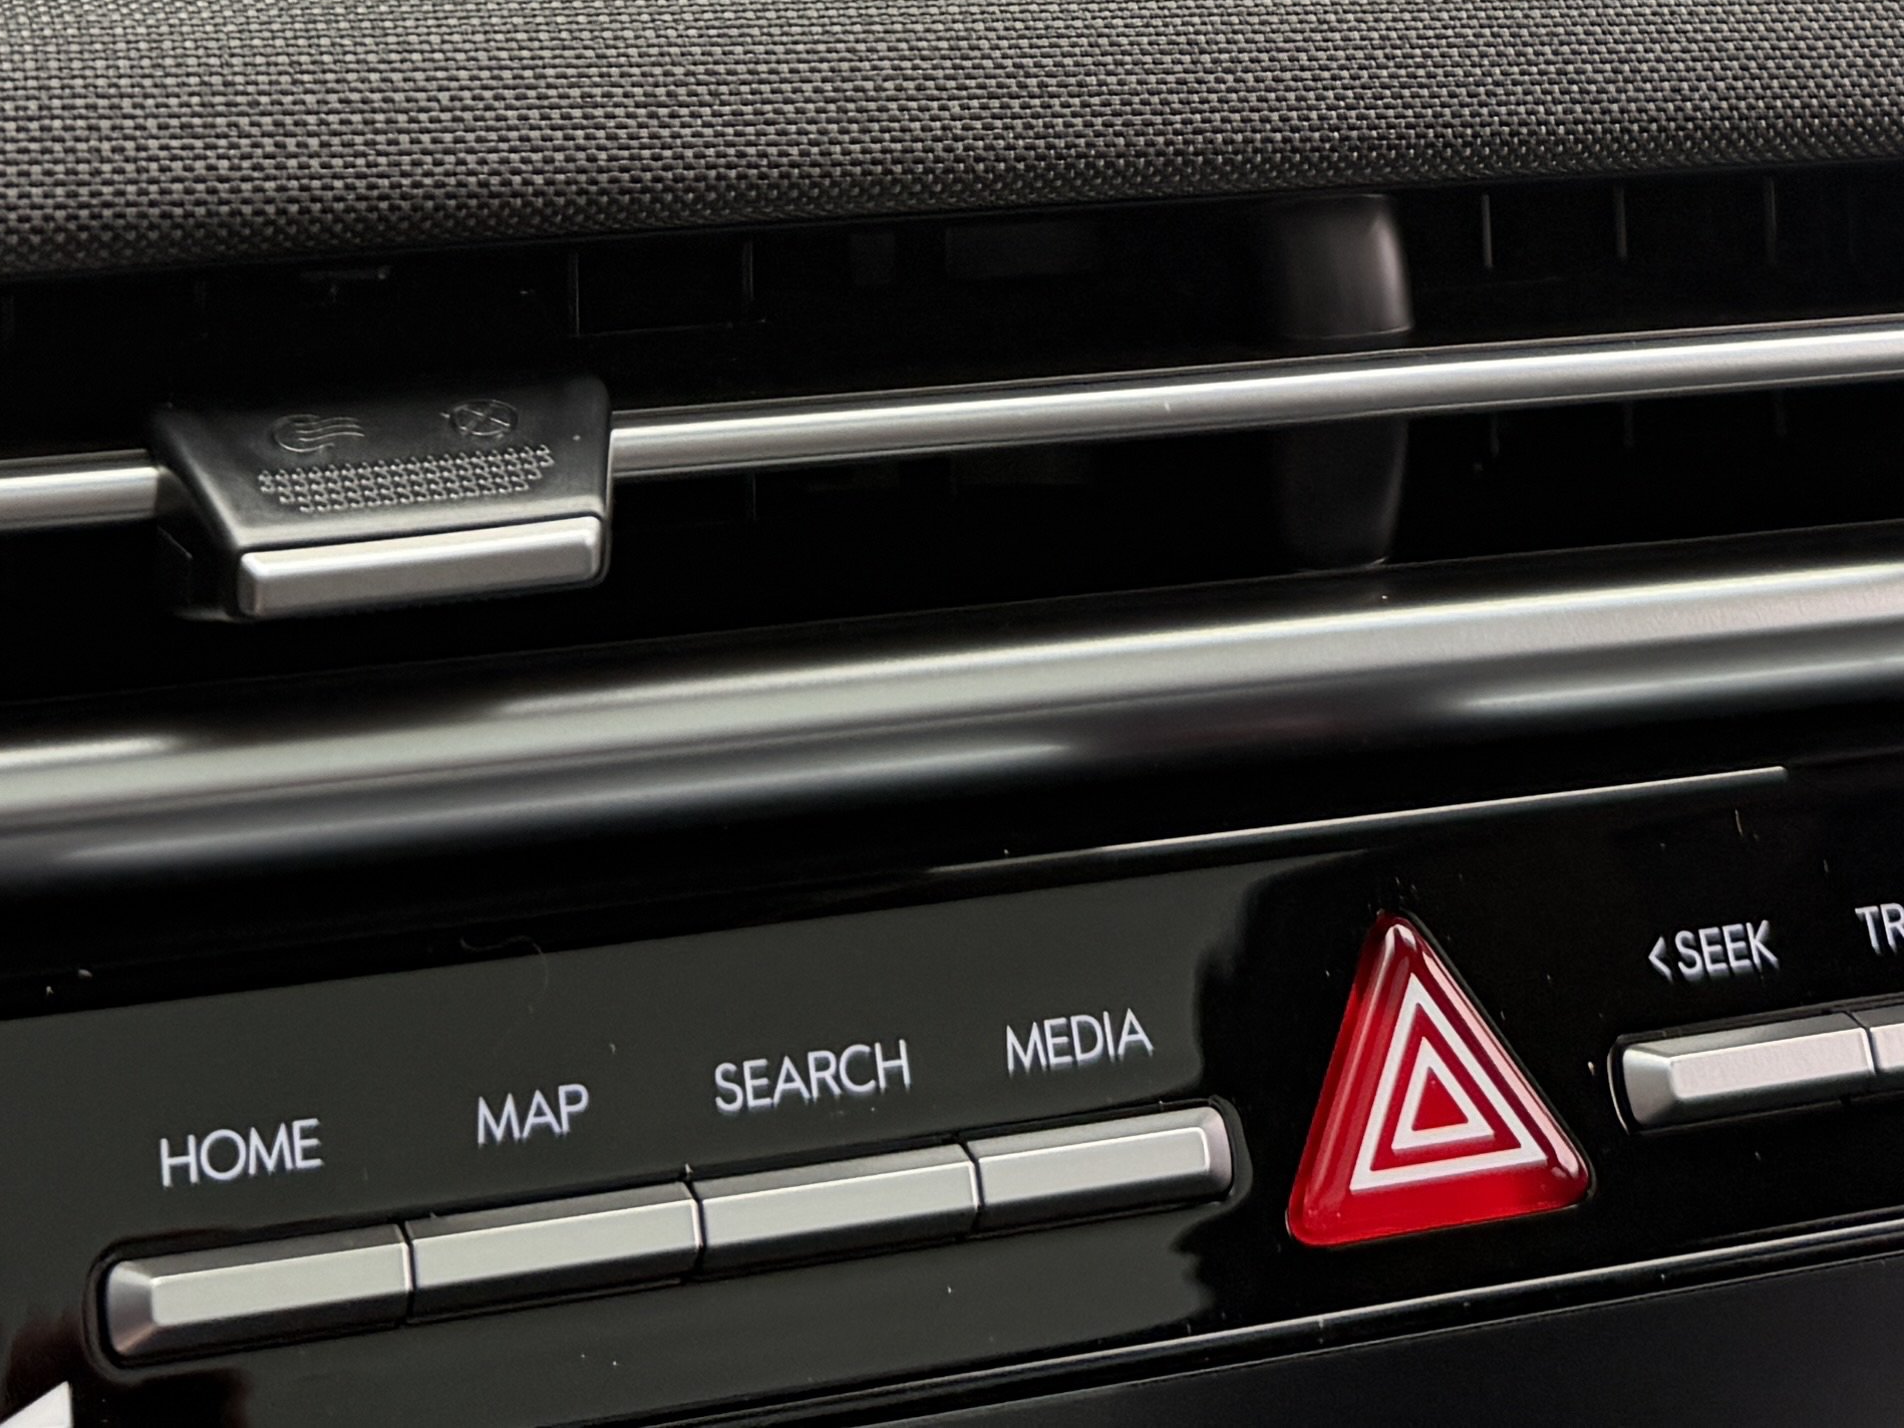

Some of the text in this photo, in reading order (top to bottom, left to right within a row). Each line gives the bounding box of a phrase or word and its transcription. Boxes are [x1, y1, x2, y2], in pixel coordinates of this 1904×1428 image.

[714, 1038, 912, 1114] SEARCH
[1005, 1007, 1154, 1076] MEDIA
[477, 1083, 589, 1148] MAP
[159, 1117, 324, 1188] HOME
